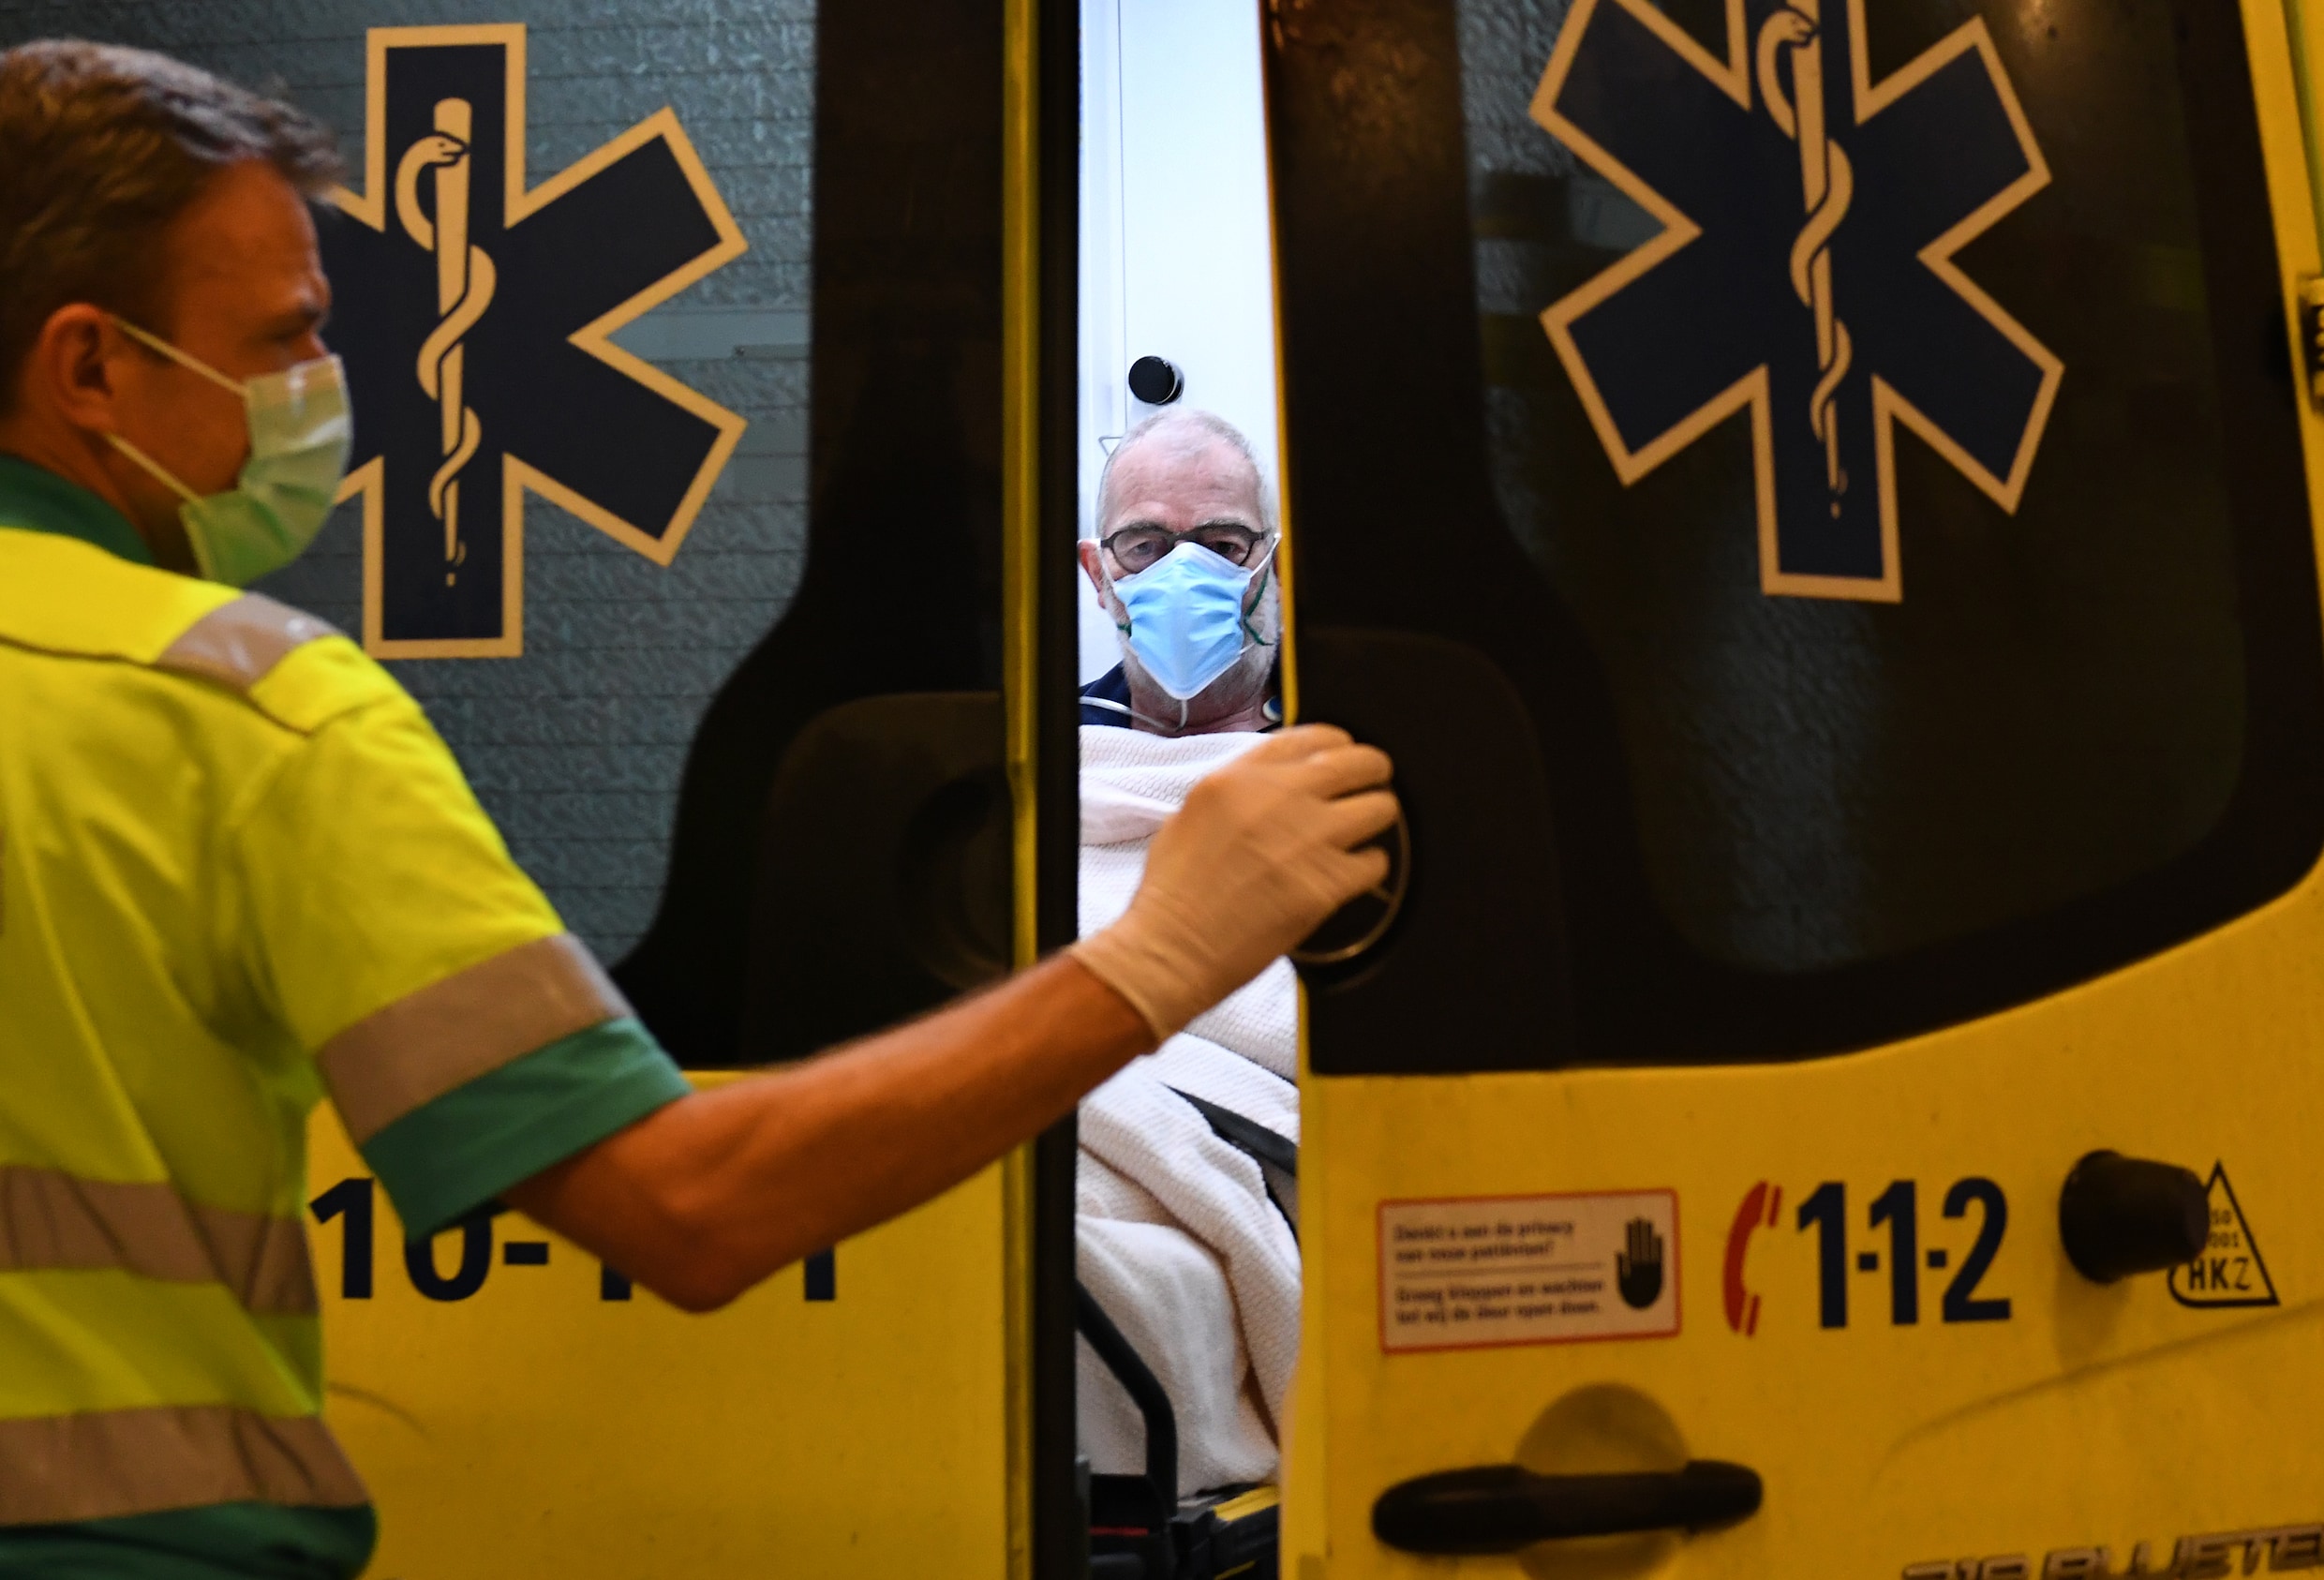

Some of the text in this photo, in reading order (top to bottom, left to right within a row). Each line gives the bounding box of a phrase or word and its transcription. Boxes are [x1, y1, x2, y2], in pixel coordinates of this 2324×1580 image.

[1518, 1221, 1574, 1238] privacy
[1796, 1177, 2011, 1329] 1-1-2
[2189, 1258, 2251, 1290] HKZ
